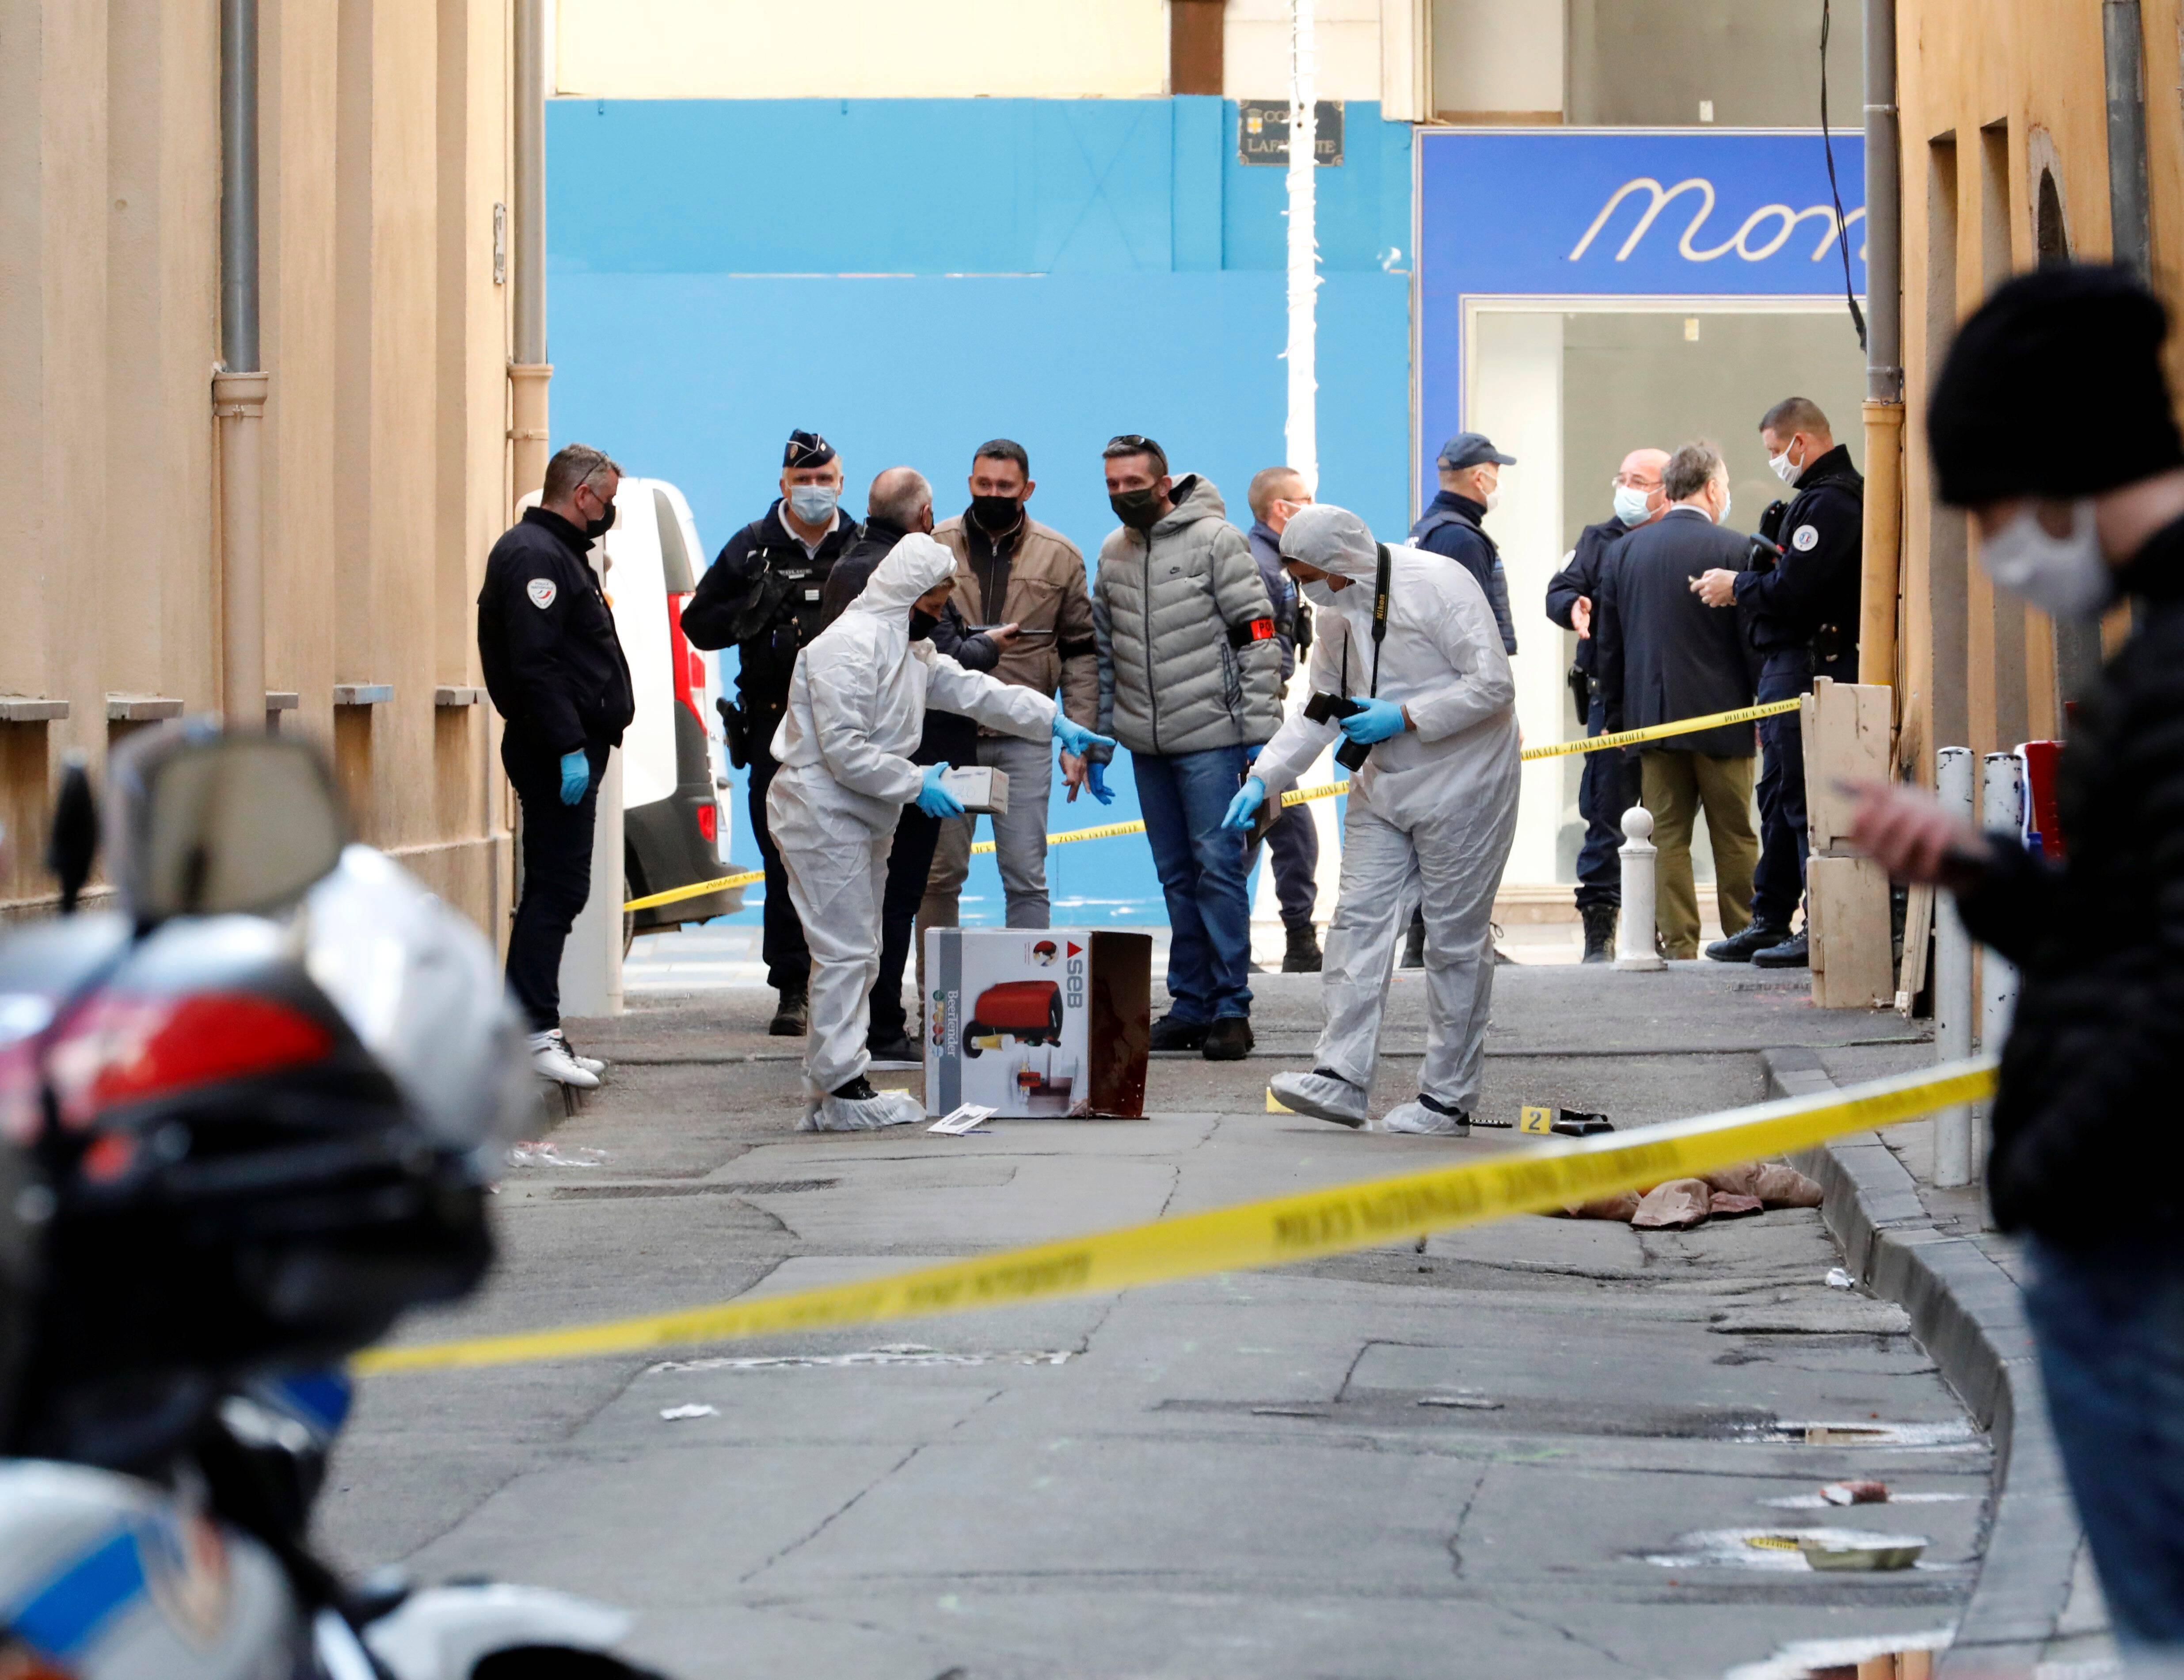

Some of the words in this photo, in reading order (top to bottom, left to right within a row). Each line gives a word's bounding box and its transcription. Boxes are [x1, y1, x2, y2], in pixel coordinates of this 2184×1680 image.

[1377, 594, 1385, 620] Nikon
[947, 990, 958, 1057] BeerTender
[1529, 1110, 1541, 1130] 2
